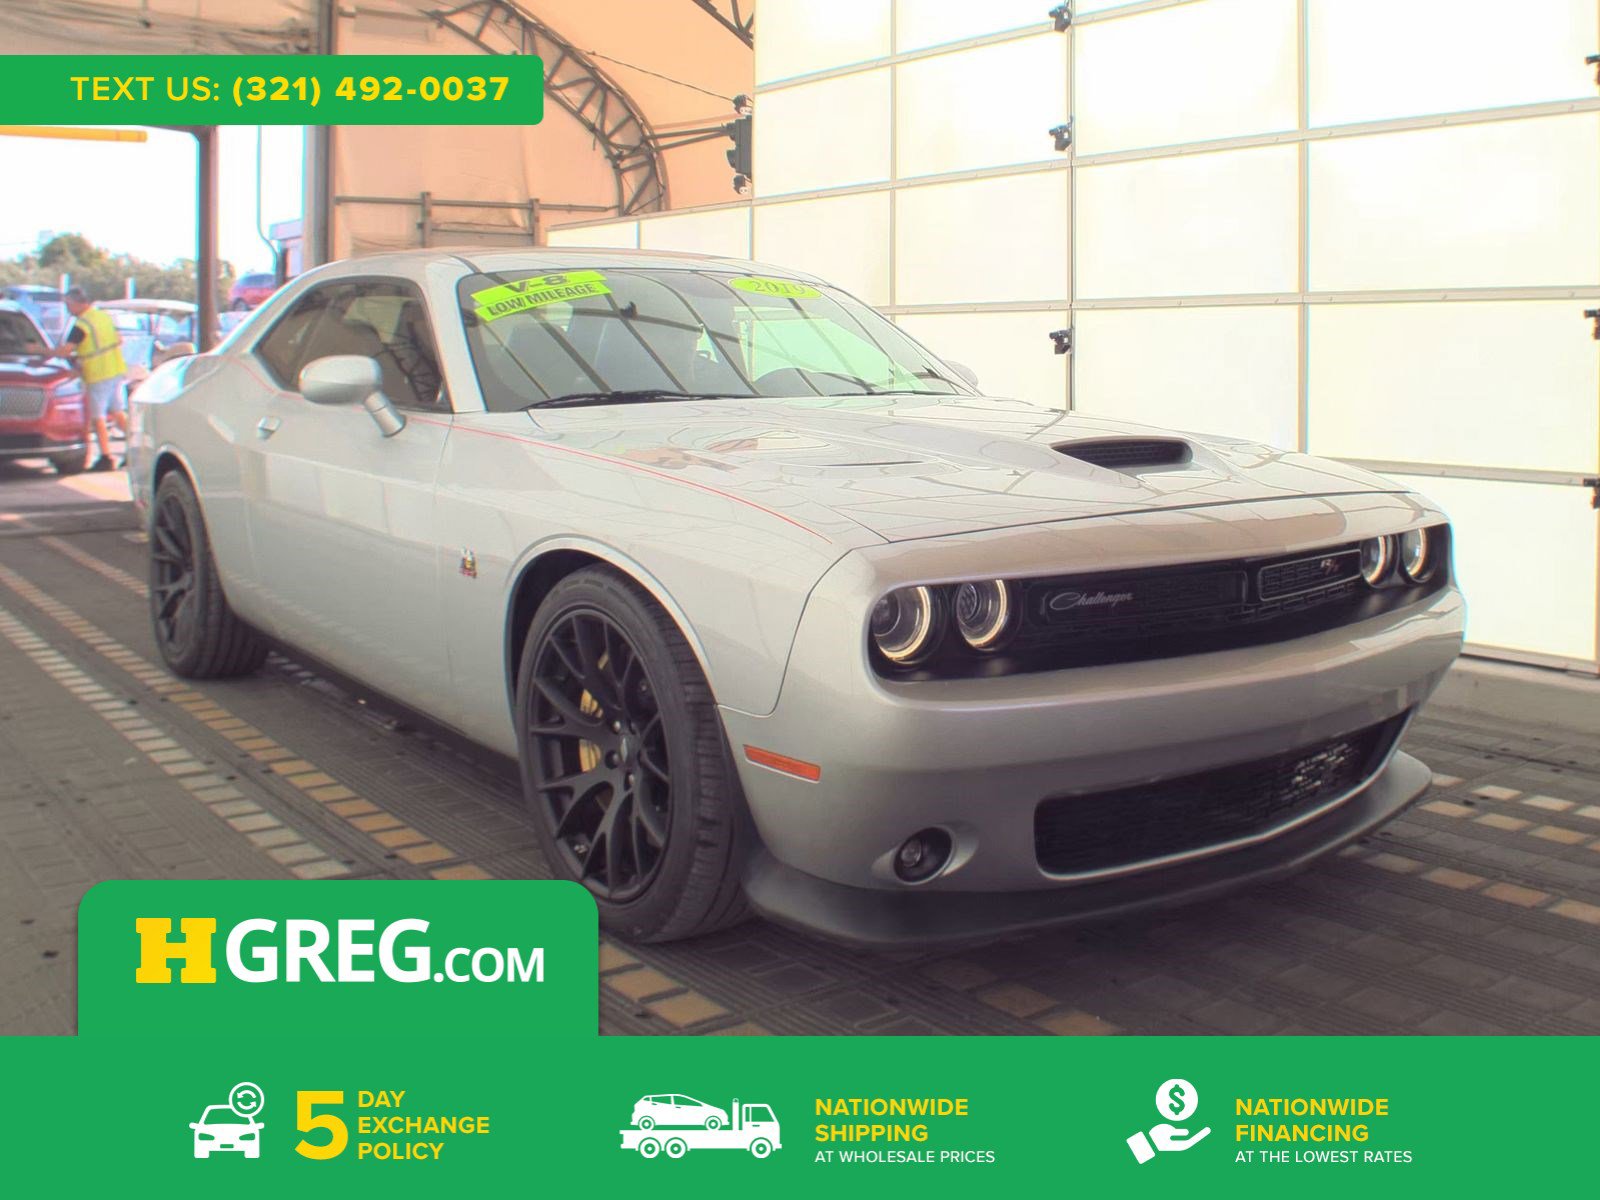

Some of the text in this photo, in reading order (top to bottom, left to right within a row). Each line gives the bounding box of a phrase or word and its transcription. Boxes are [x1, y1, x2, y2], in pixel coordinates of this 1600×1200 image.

[503, 274, 568, 293] V-8
[749, 280, 806, 295] 2019
[486, 283, 597, 316] LOW MILEAGE
[1049, 591, 1134, 611] Challenger
